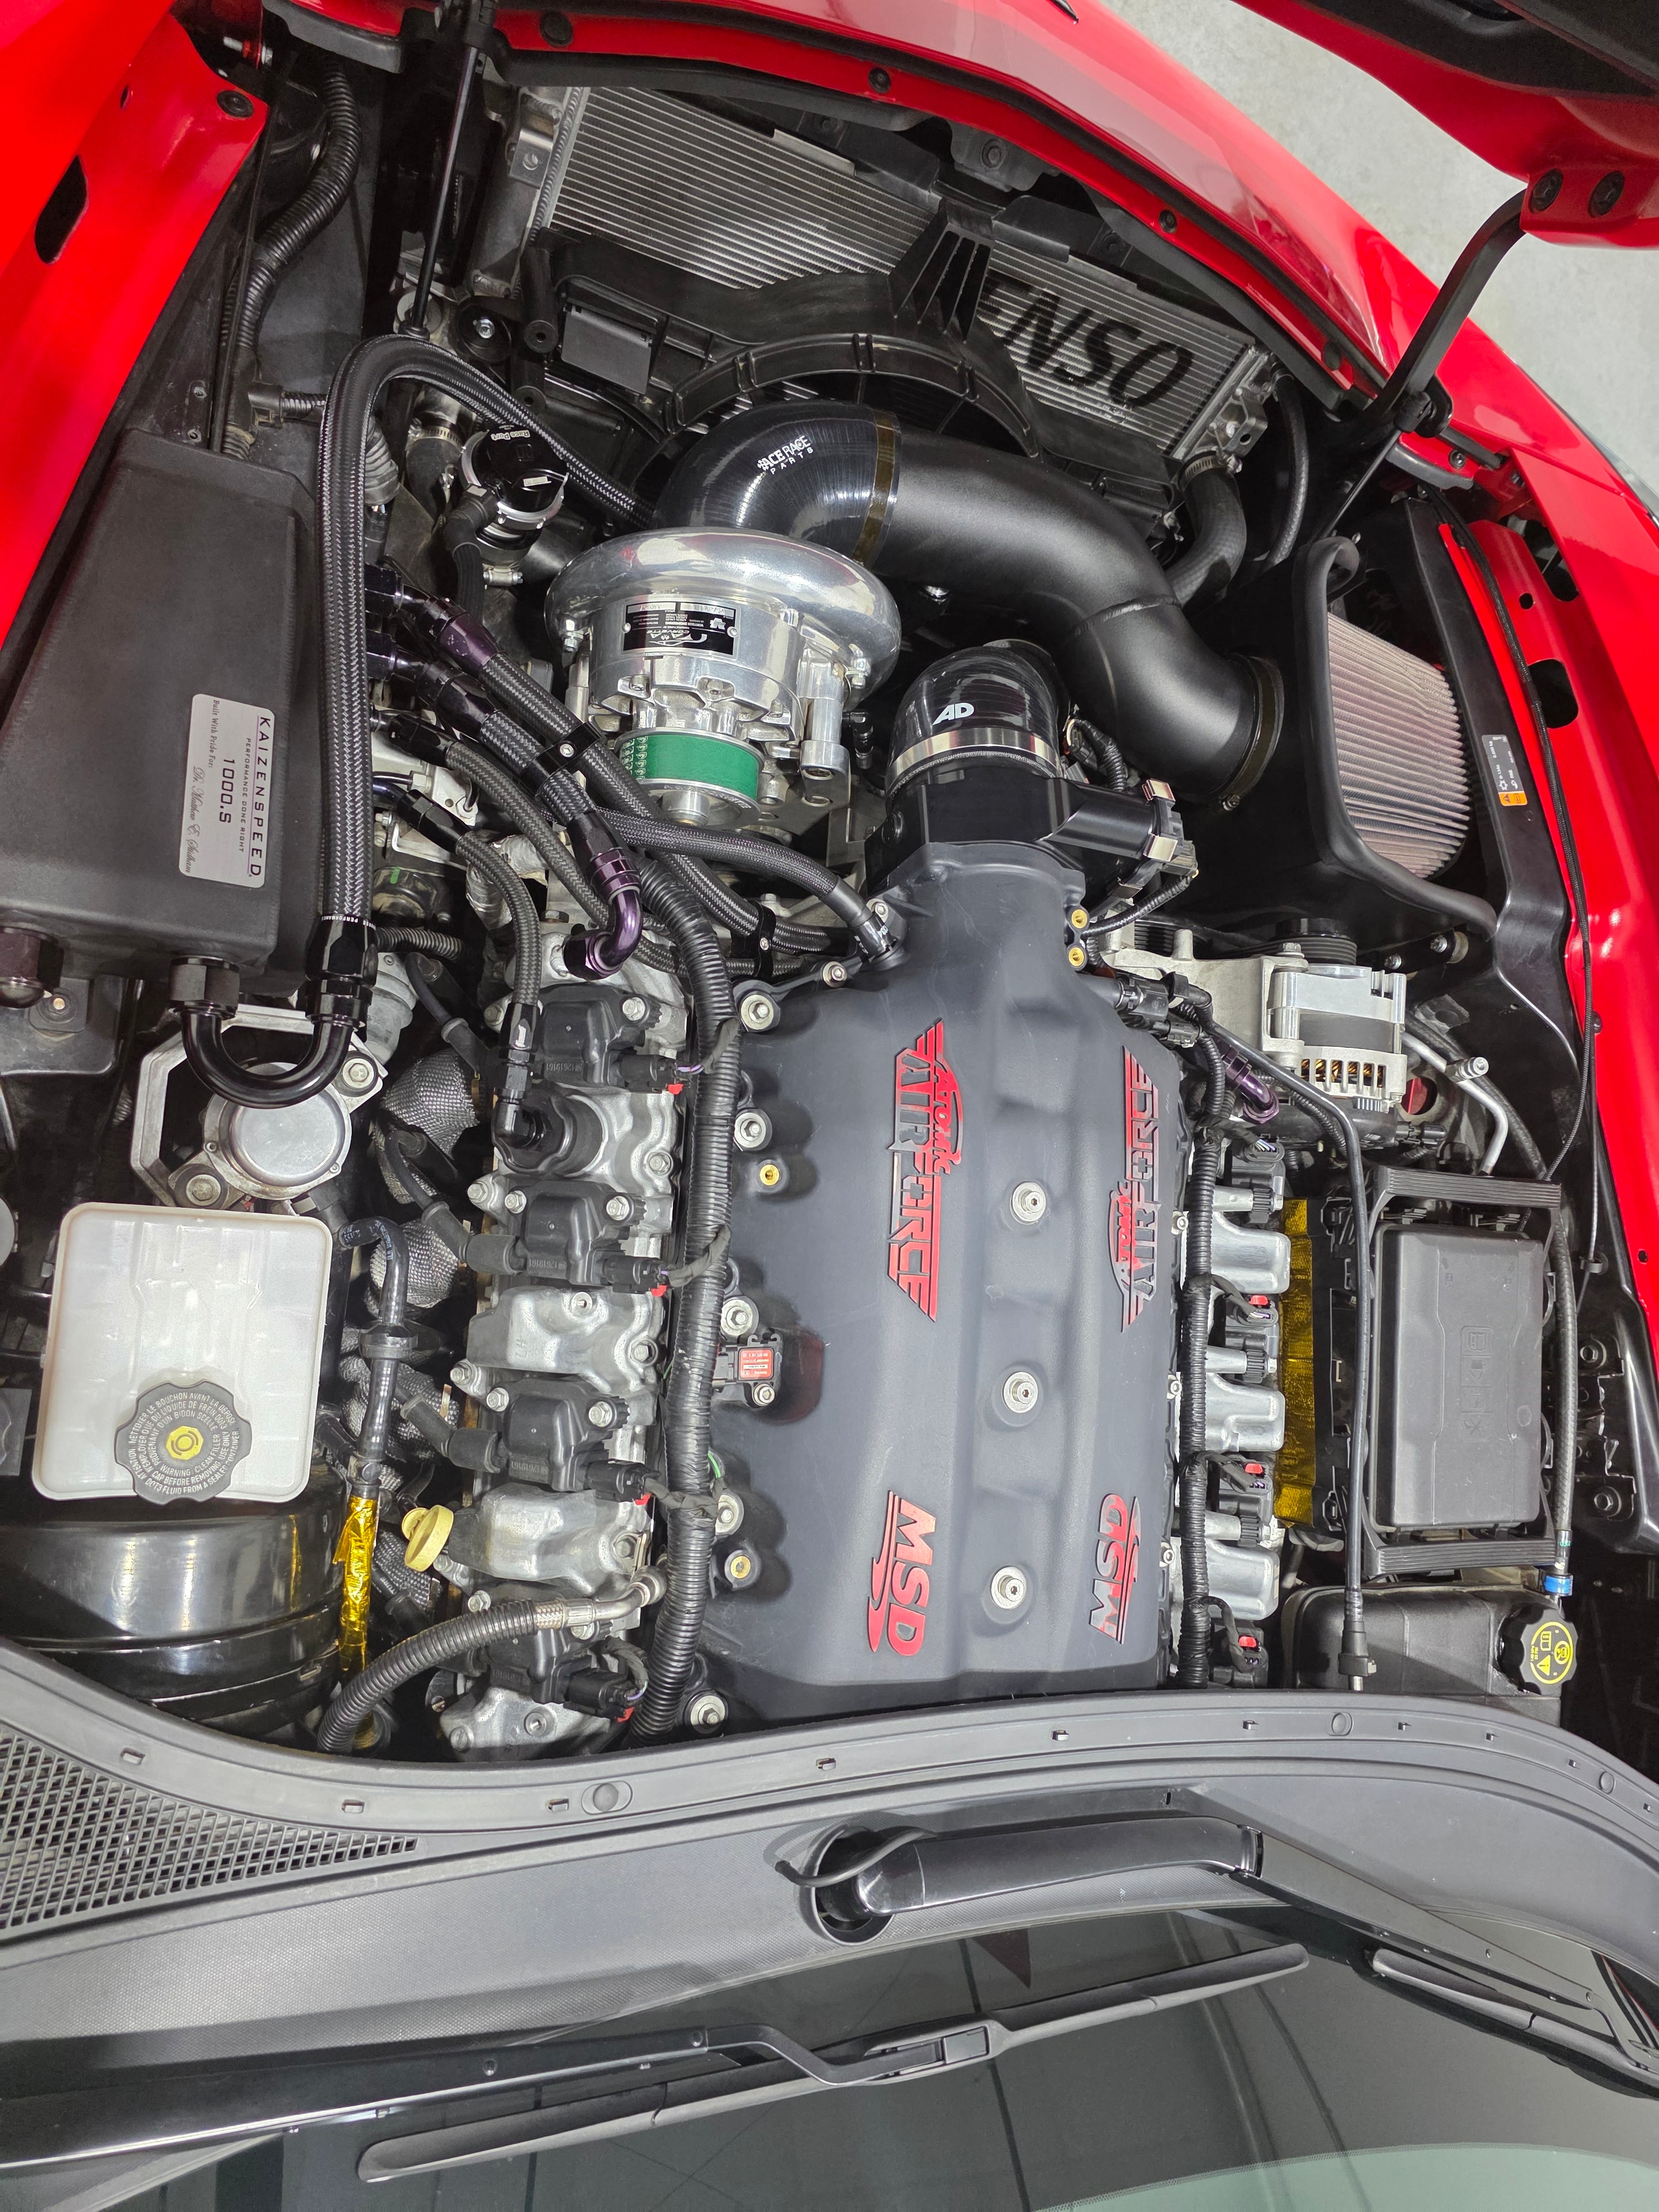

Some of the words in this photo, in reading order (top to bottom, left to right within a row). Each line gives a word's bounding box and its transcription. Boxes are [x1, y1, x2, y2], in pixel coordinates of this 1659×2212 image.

[978, 268, 1194, 408] ENSO
[770, 447, 813, 475] PARTS
[782, 435, 811, 457] RACE
[932, 702, 975, 726] AD
[210, 735, 218, 753] Pride
[193, 766, 206, 785] Dr.
[243, 738, 252, 797] PERFORMANCE
[190, 783, 204, 821] Matthew
[250, 716, 271, 876] KAIZENSPEED
[185, 838, 198, 874] Stidham
[238, 827, 246, 853] RIGHT
[128, 1412, 150, 1444] NETTOYER
[146, 1404, 157, 1415] LE
[156, 1392, 188, 1408] BOUCHON
[189, 1392, 210, 1402] AVANT
[210, 1398, 219, 1408] LA
[141, 1421, 155, 1435] QUE
[151, 1412, 161, 1422] DU
[162, 1401, 187, 1415] LIQUIDE
[188, 1400, 197, 1408] DE
[198, 1402, 217, 1417] FREIN
[148, 1428, 162, 1466] PROVENANT
[157, 1415, 173, 1429] D'UN
[174, 1410, 196, 1419] BIDON
[221, 1430, 230, 1448] ONLY
[160, 1463, 194, 1476] WARNING:
[195, 1455, 215, 1473] CLEAN
[210, 1433, 221, 1456] FILLER
[218, 1448, 228, 1461] USE
[145, 1477, 163, 1491] DOT3
[162, 1484, 182, 1494] FLUID
[183, 1484, 203, 1493] FROM
[209, 1464, 229, 1485] SEALED
[151, 1469, 165, 1481] CAP
[164, 1475, 191, 1486] BEFORE
[887, 1498, 936, 1656] MSD
[1089, 1493, 1128, 1638] MSD
